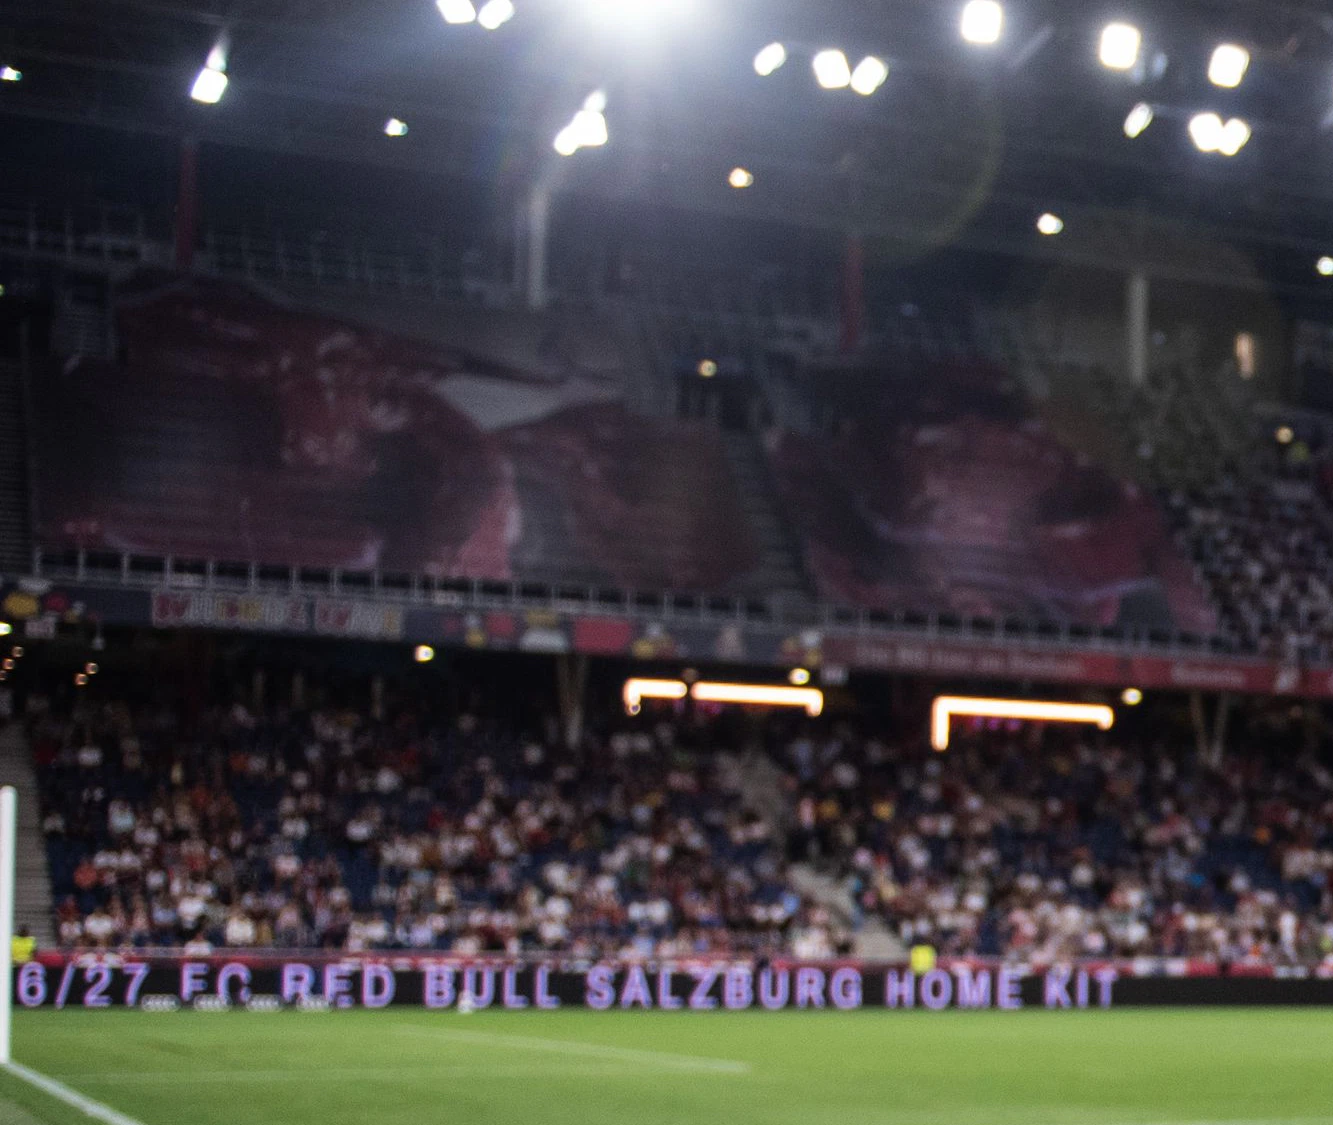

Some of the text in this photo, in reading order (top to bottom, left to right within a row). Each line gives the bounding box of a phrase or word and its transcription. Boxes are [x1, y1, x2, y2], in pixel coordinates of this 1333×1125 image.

[181, 962, 253, 1002] FC
[282, 962, 396, 1008] RED
[425, 963, 560, 1009] BULL
[585, 965, 863, 1010] SALZBURG
[885, 967, 1024, 1010] HOME
[1045, 968, 1119, 1010] KIT
